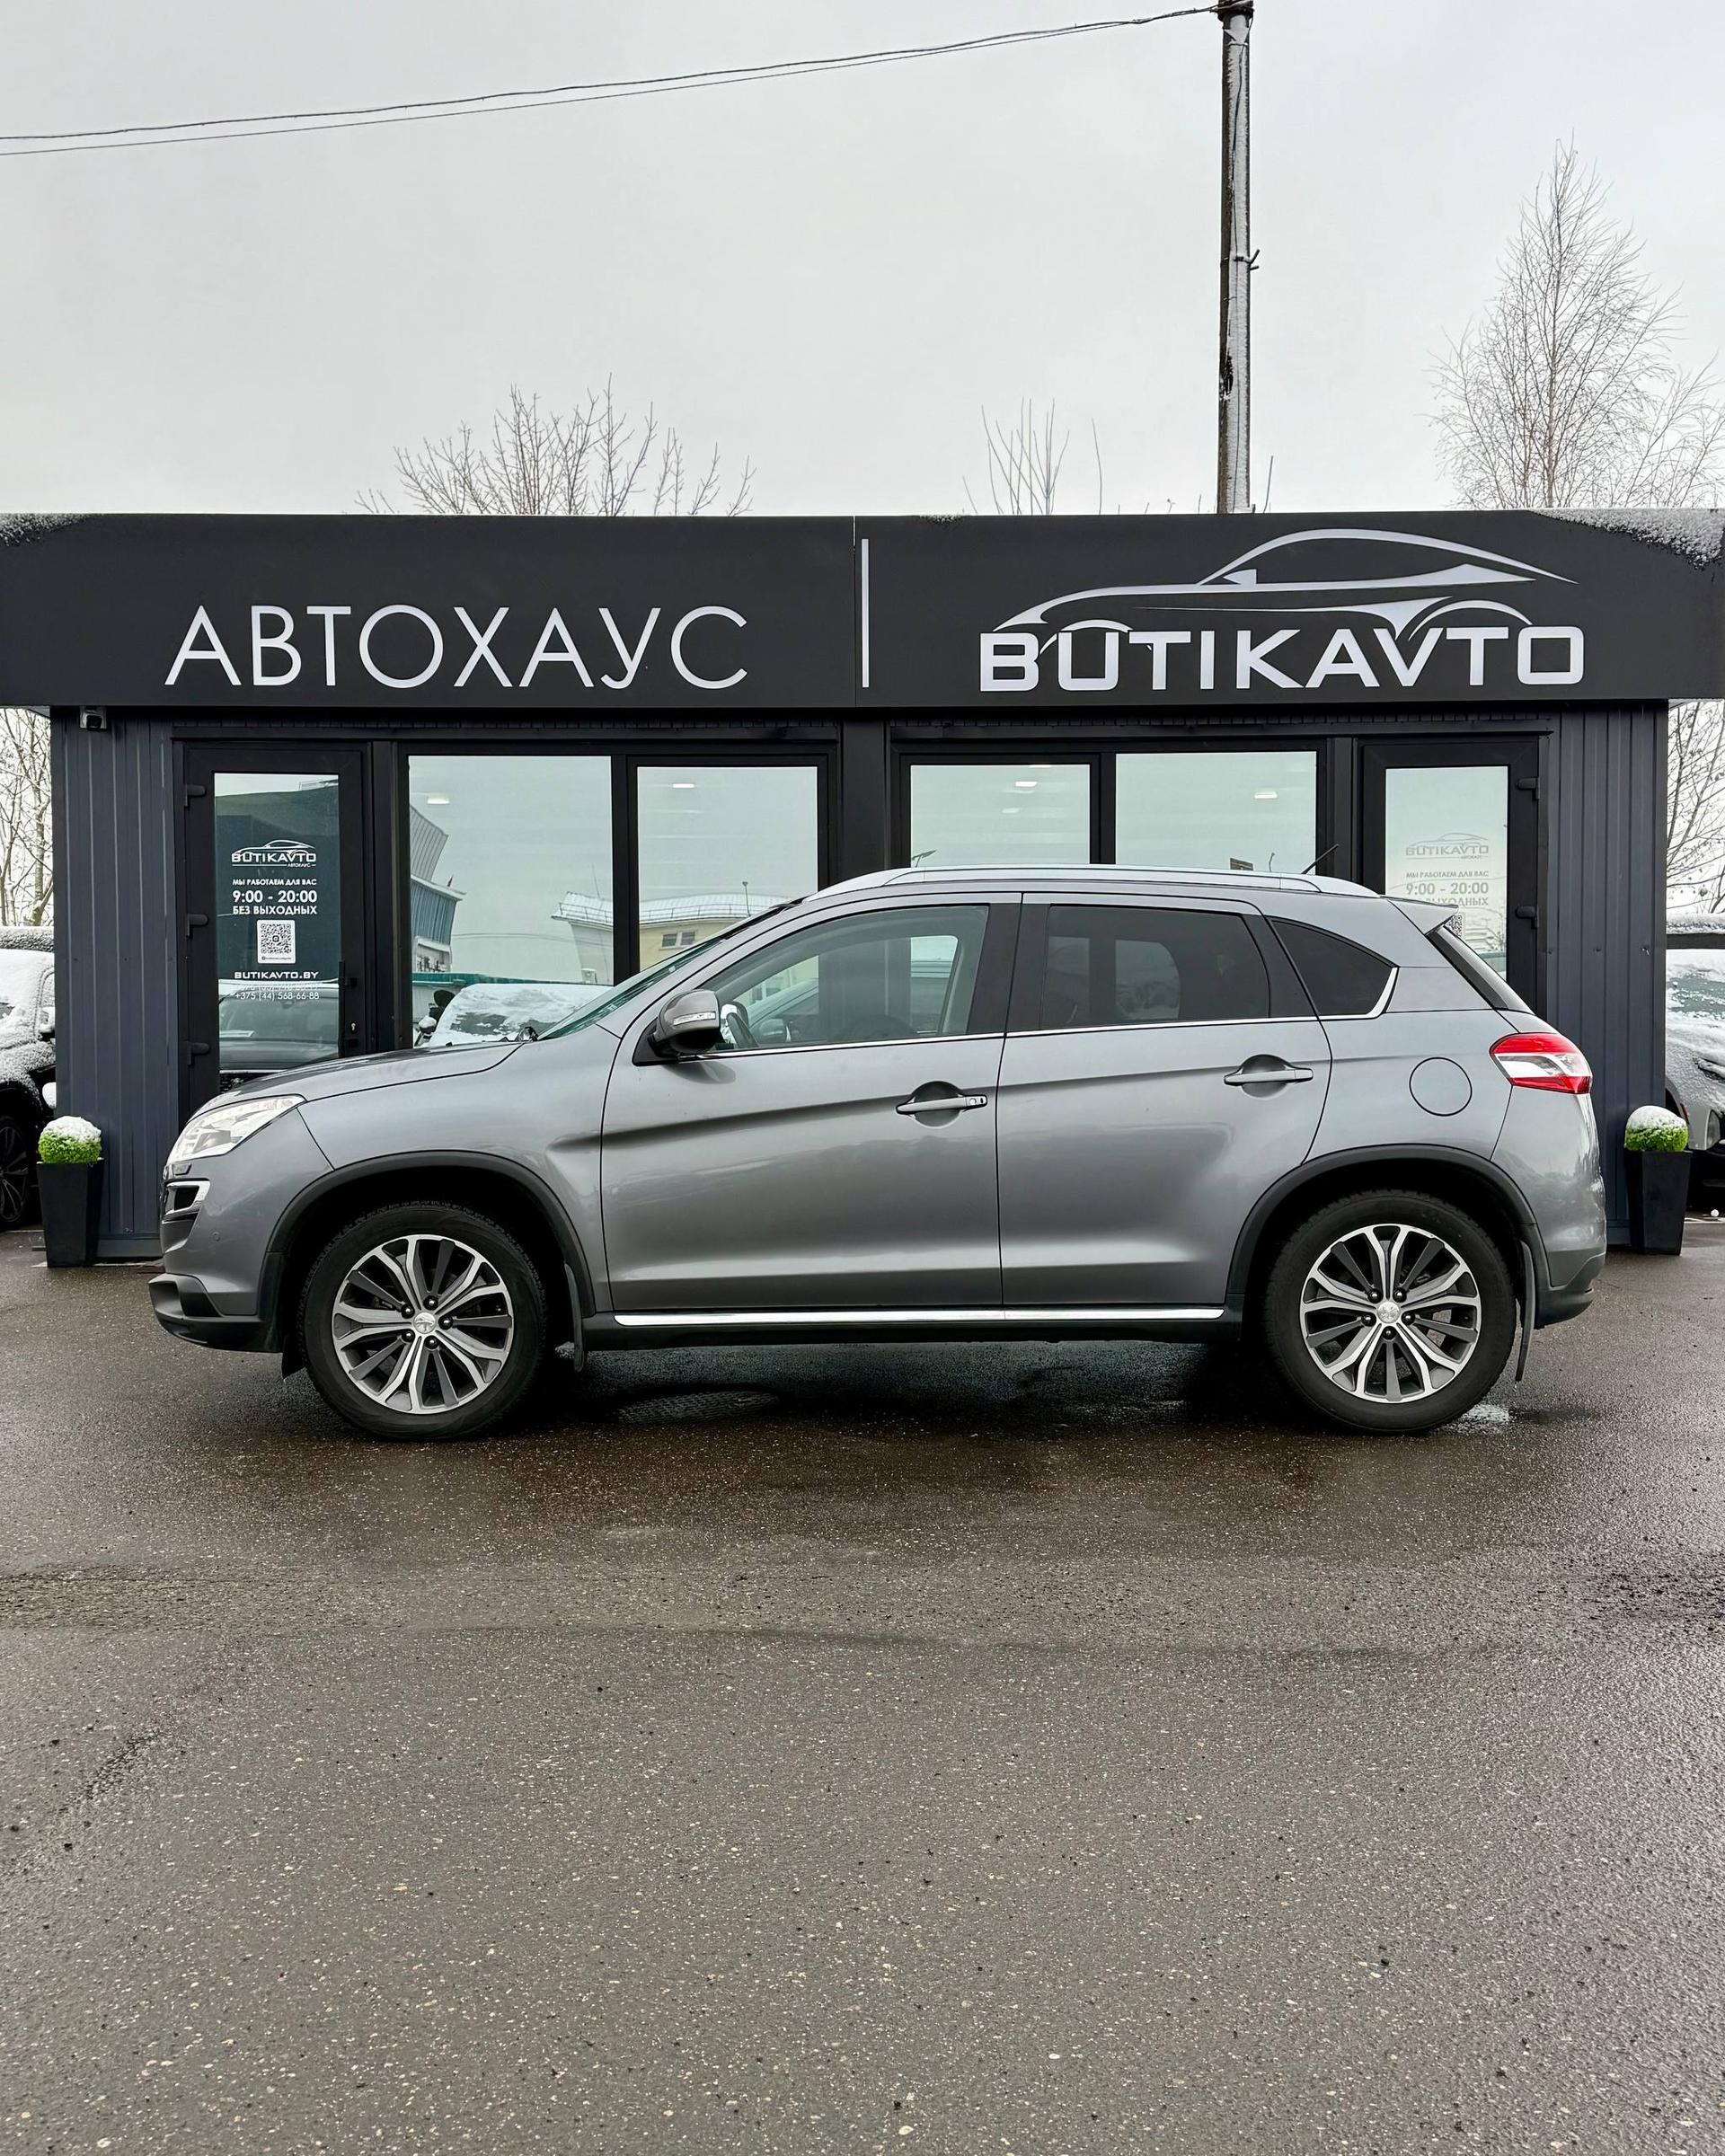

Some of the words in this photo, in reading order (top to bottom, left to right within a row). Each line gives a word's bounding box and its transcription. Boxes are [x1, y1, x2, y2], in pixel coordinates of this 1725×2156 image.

[165, 604, 749, 690] АВТОХАУС
[980, 625, 1585, 692] BUTIKAVTO
[1405, 845, 1488, 855] BUTIKAVTO
[231, 853, 316, 862] BUTIKAVTO
[1406, 883, 1436, 895] 9:00
[1450, 882, 1489, 895] 20:00
[232, 889, 263, 903] 9:00
[278, 889, 317, 903] 20:00
[233, 905, 251, 915] БЕЗ
[252, 905, 317, 915] ВЫХОДНЫХ
[234, 971, 319, 979] BUTIKAVTO.BY
[235, 992, 256, 1000] +375
[259, 992, 275, 1002] (44)
[278, 992, 319, 1000] 568-66-88
